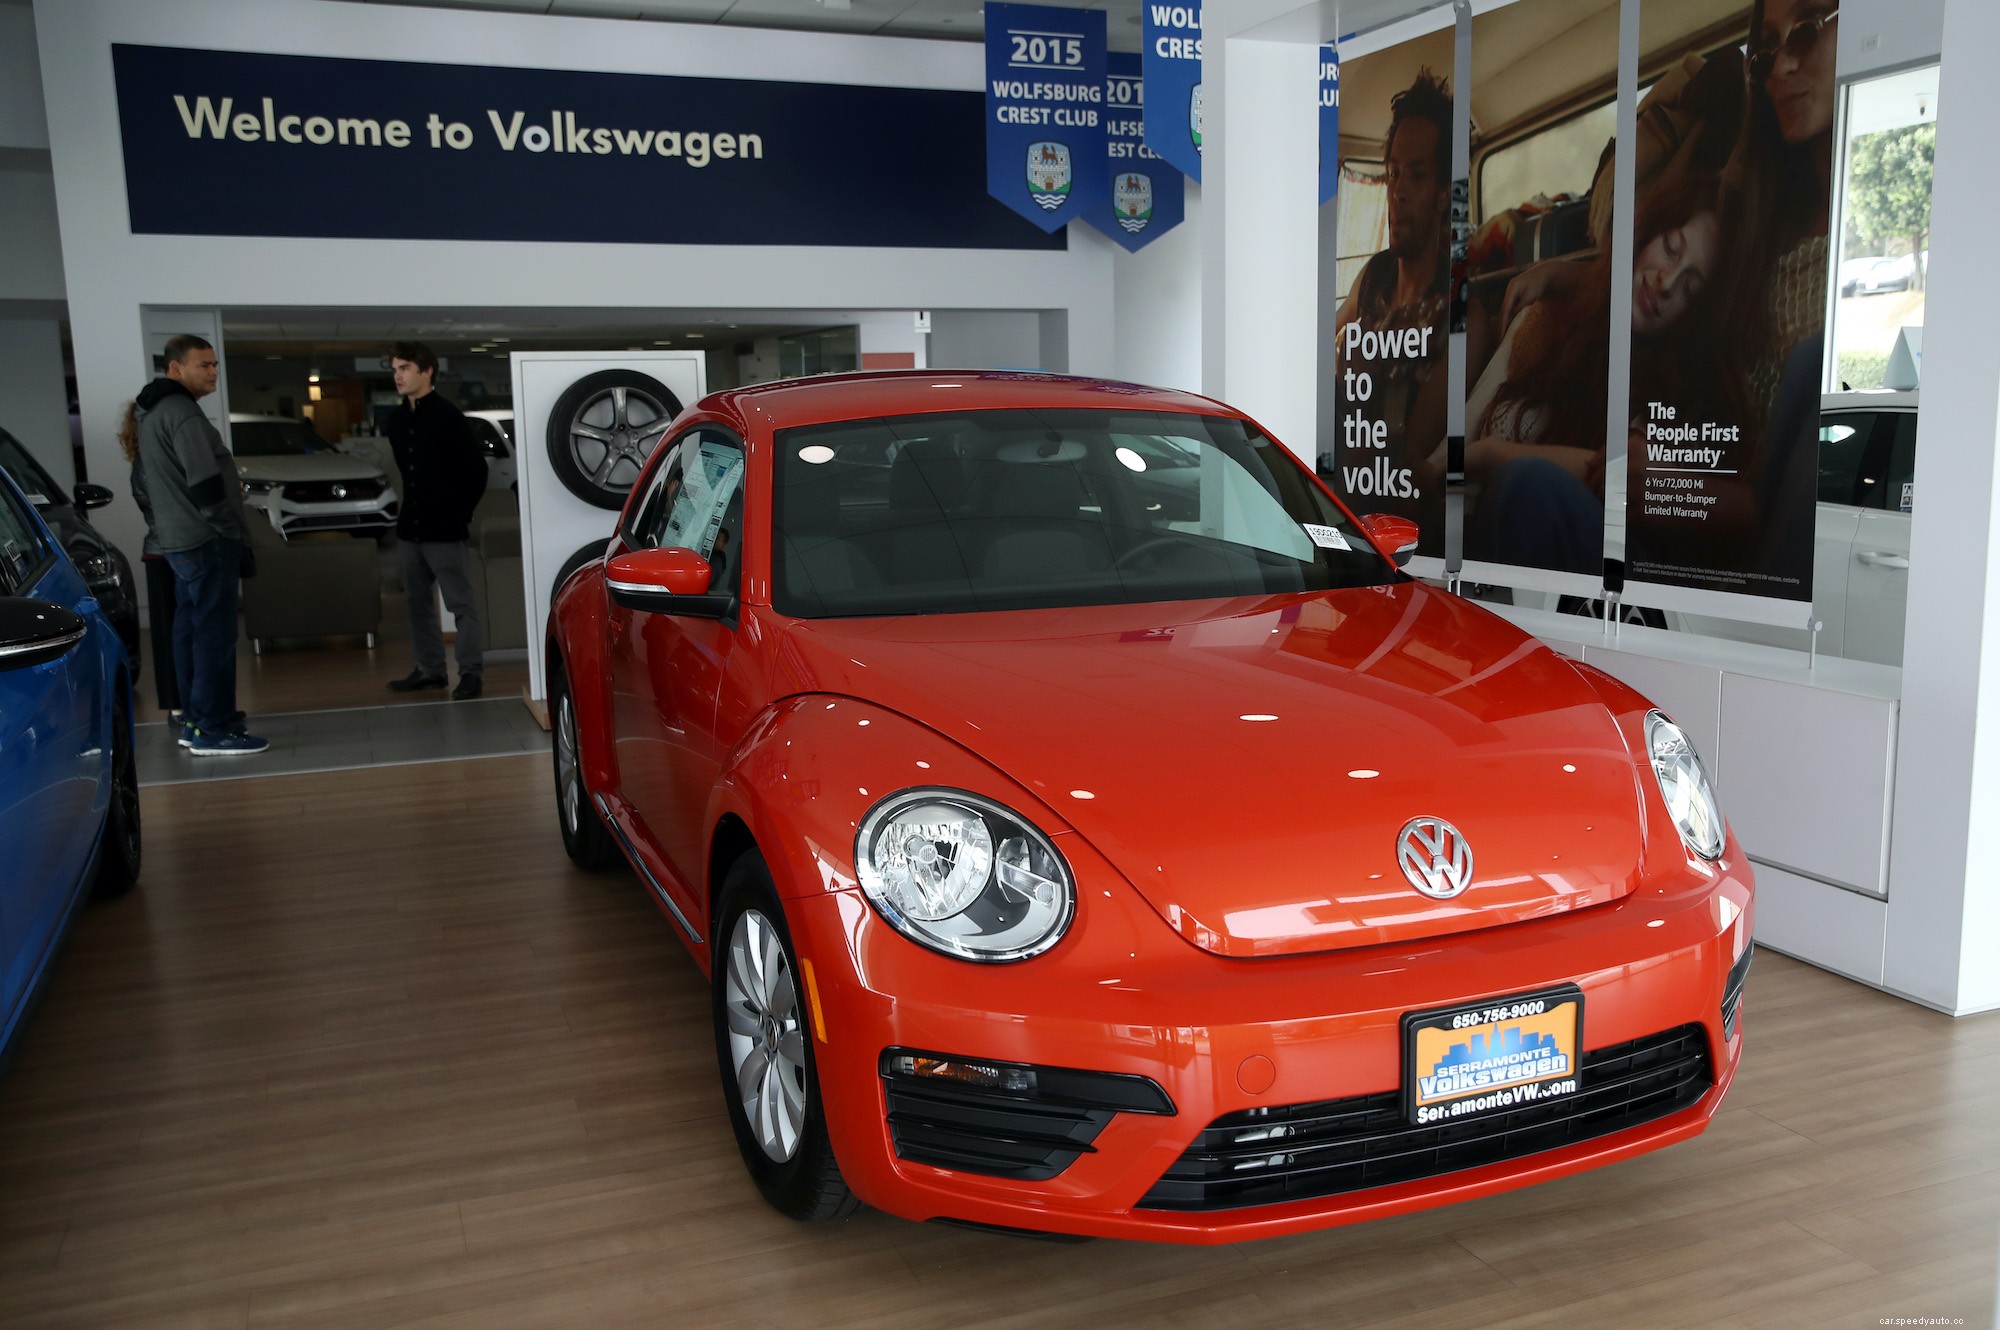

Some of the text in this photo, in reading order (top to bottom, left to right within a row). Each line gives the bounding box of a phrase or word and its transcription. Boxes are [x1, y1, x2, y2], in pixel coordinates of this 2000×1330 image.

[1151, 5, 1202, 29] WOL
[1010, 36, 1083, 66] 2015
[992, 80, 1101, 103] WOLFSBURG
[996, 105, 1099, 127] CREST CLUB
[174, 95, 764, 168] Welcome to Volkswagen
[1345, 322, 1433, 361] Power
[1344, 367, 1372, 401] to
[1648, 402, 1676, 420] The
[1343, 408, 1388, 449] the
[1646, 422, 1740, 446] People First
[1342, 456, 1421, 500] volks.
[1645, 477, 1704, 490] 6 Yrs/72,000 Mi
[1645, 491, 1717, 505] Bumper-to-Bumper
[1644, 505, 1708, 521] Limited Warranty
[1452, 1000, 1545, 1029] 650-756-9000
[1418, 1053, 1567, 1096] Volkswagen
[1436, 1046, 1551, 1078] SERRAMONTE
